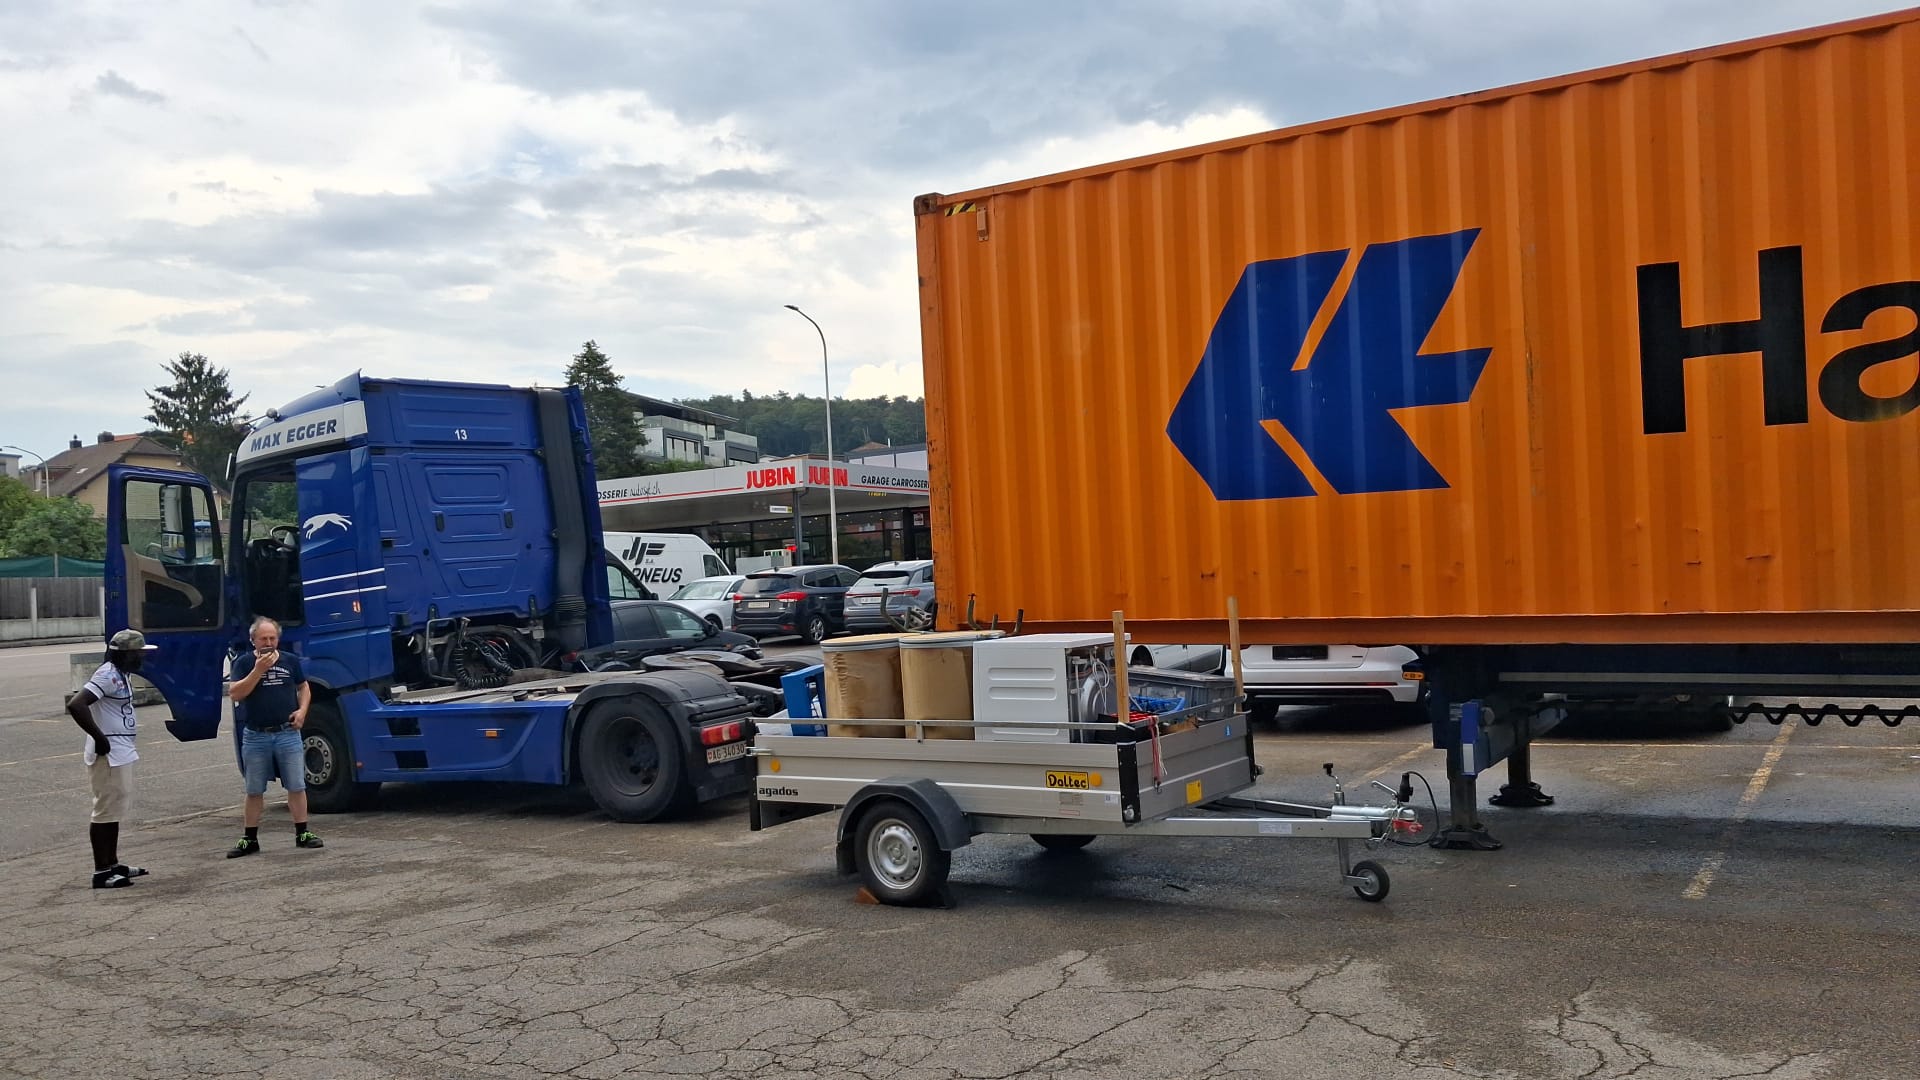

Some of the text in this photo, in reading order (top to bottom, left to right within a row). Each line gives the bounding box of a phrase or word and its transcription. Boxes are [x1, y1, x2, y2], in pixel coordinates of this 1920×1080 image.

[1636, 245, 1920, 434] Ha
[250, 419, 337, 452] MAX EGGER
[455, 429, 467, 440] 13
[746, 466, 796, 489] JUBIN
[861, 475, 890, 486] GARAGE
[759, 787, 799, 797] agados
